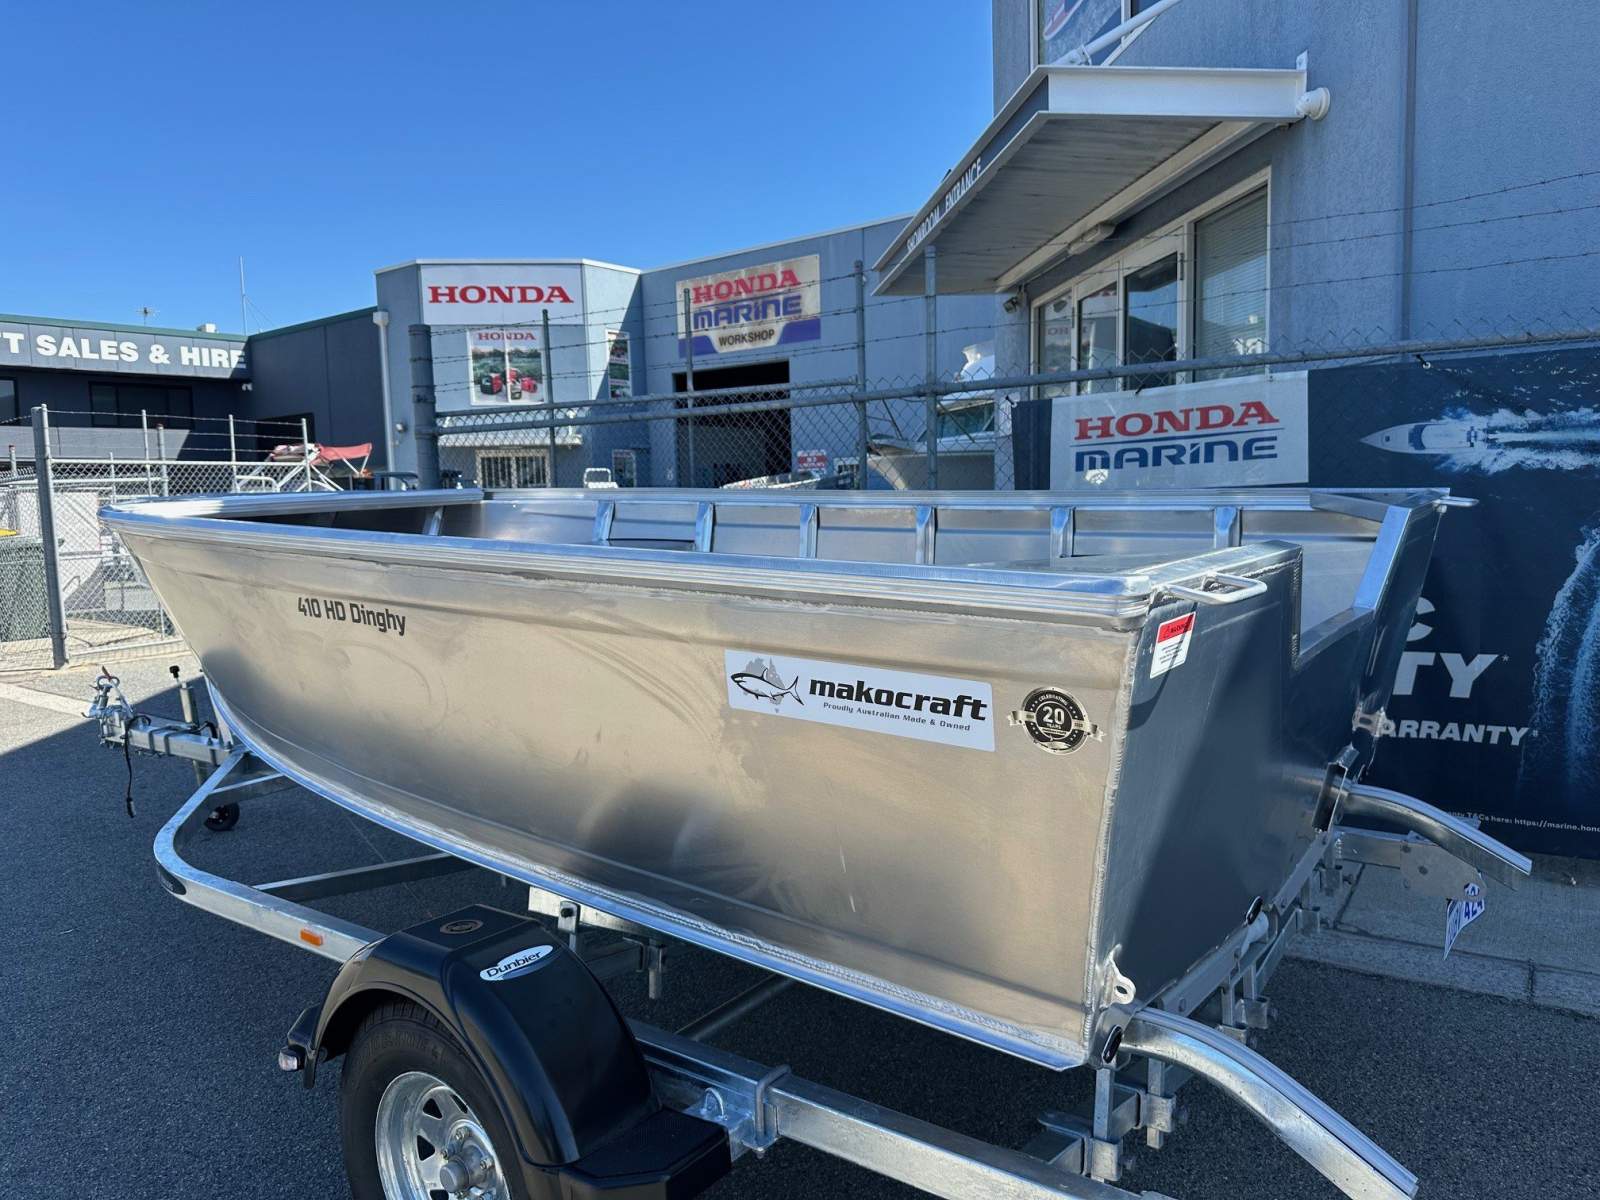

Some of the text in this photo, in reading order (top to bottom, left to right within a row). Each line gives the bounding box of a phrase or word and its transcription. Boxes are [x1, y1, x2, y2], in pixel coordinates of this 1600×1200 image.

[945, 157, 981, 213] ENTRANCE
[428, 286, 574, 303] HONDA
[692, 269, 801, 304] HONDA
[693, 295, 802, 329] MARINE
[0, 332, 246, 369] T SALES & HIRE
[478, 332, 537, 341] HONDA
[718, 329, 775, 347] WORKSHOP
[1074, 401, 1280, 440] HONDA
[1075, 436, 1277, 472] MARINE
[298, 597, 406, 636] 410 HD Dinghy
[809, 679, 988, 721] makocraft
[823, 702, 854, 714] Proudly
[856, 707, 900, 720] Australian
[903, 714, 926, 724] Made
[939, 720, 971, 731] Owned
[1042, 706, 1065, 725] 20
[486, 951, 542, 978] Dunbier
